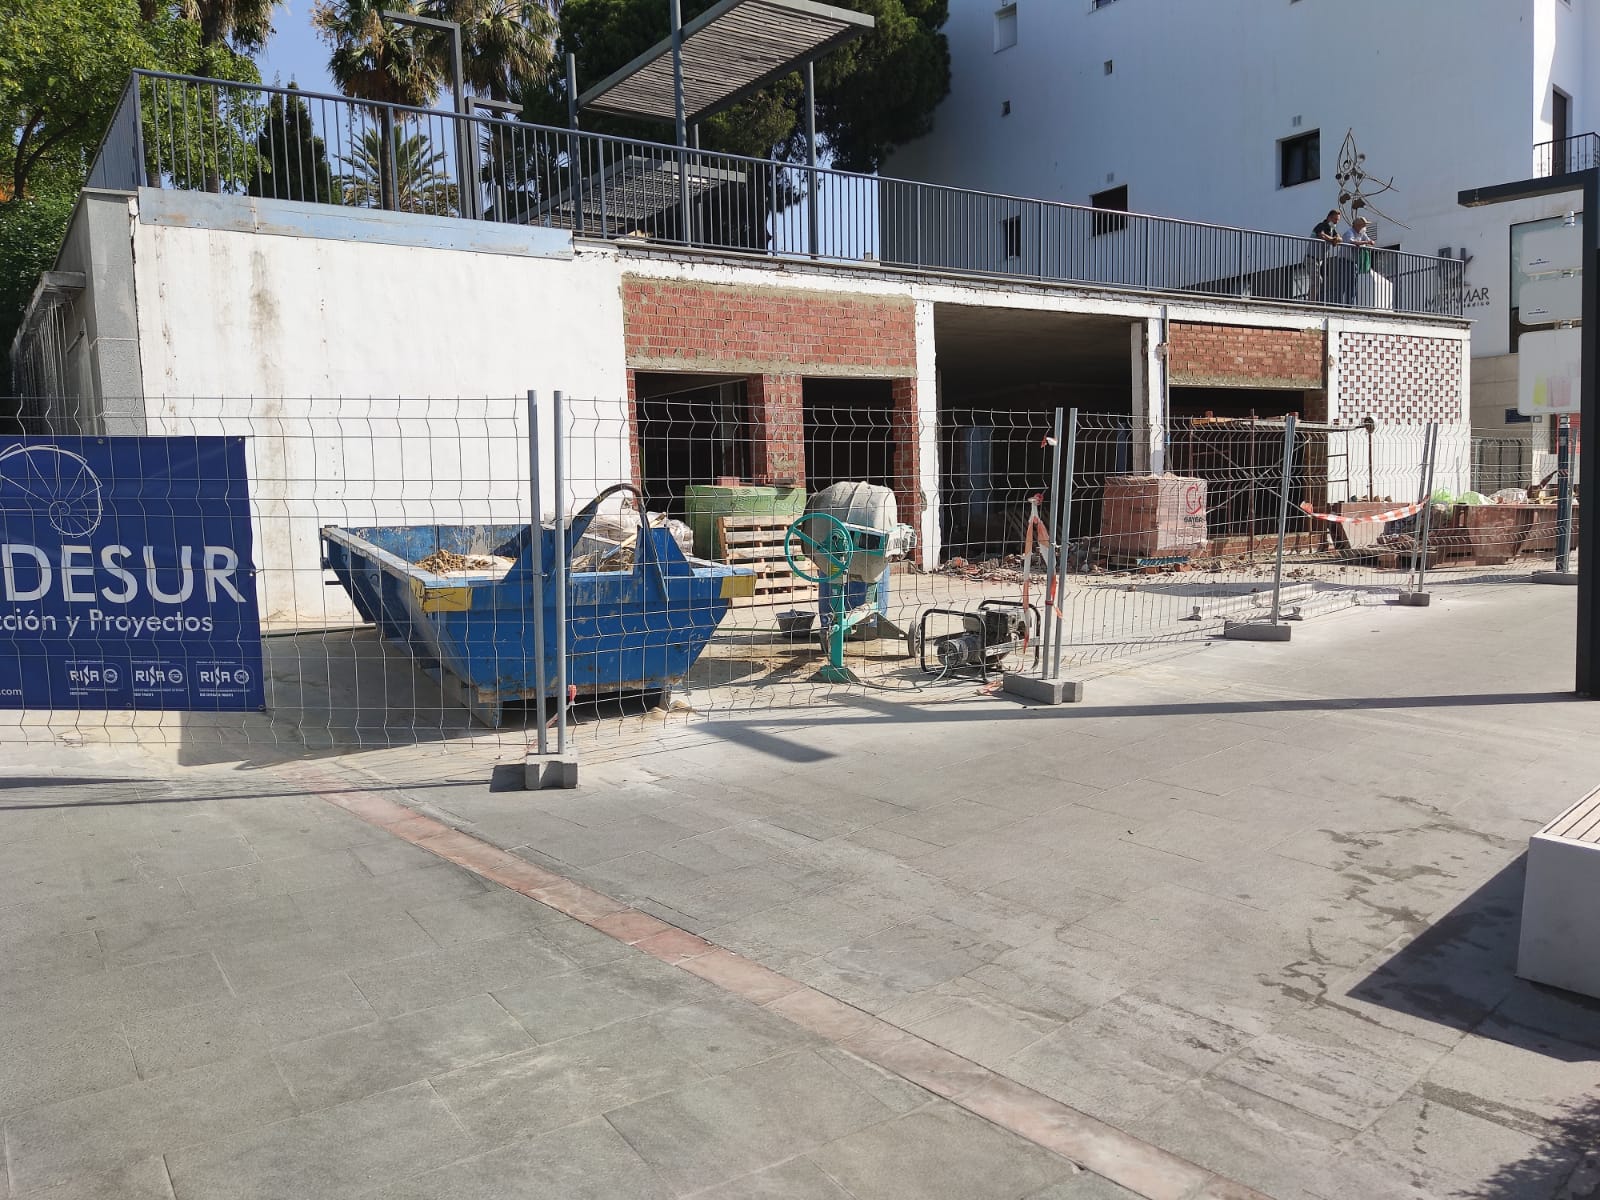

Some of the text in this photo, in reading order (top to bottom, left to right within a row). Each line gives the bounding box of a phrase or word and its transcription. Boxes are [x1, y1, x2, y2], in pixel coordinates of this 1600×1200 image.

[1, 543, 248, 604] DESUR
[65, 615, 80, 637] y
[89, 609, 214, 638] Proyectos
